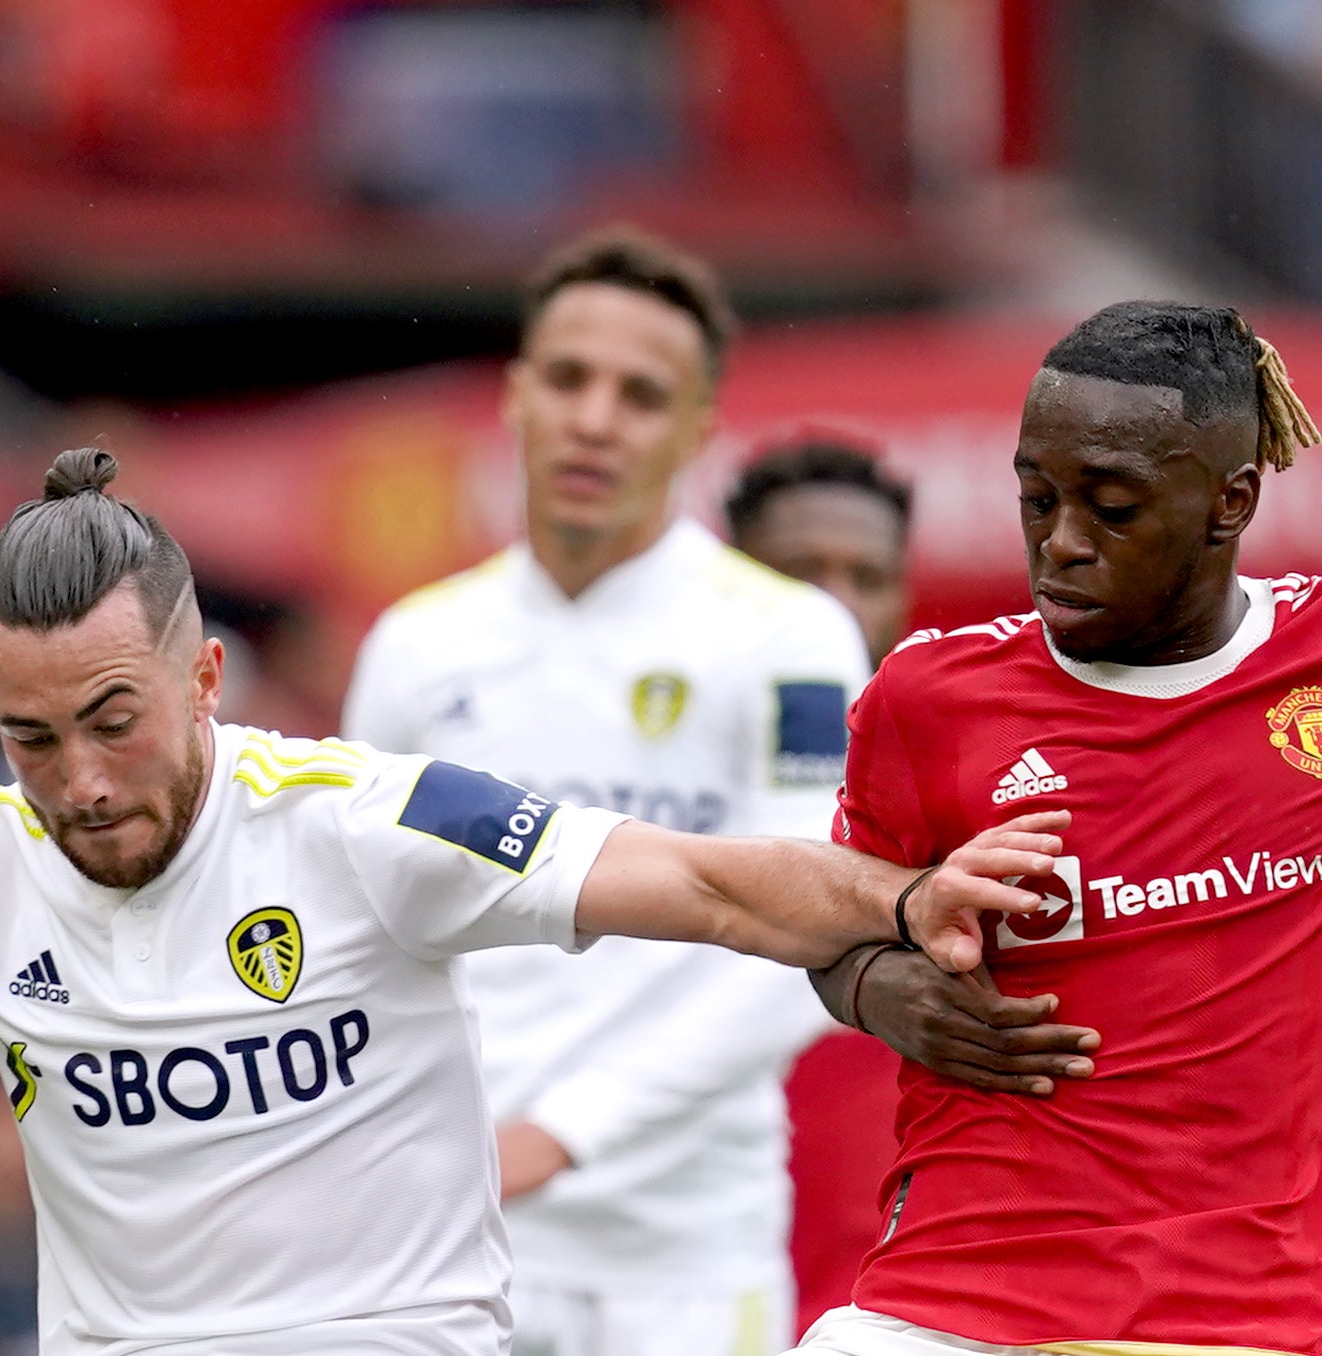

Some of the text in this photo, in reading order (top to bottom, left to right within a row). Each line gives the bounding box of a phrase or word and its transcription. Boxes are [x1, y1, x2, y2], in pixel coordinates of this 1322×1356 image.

[991, 774, 1068, 805] adidas
[9, 979, 70, 1004] adidas
[64, 1009, 369, 1127] SBOTOP
